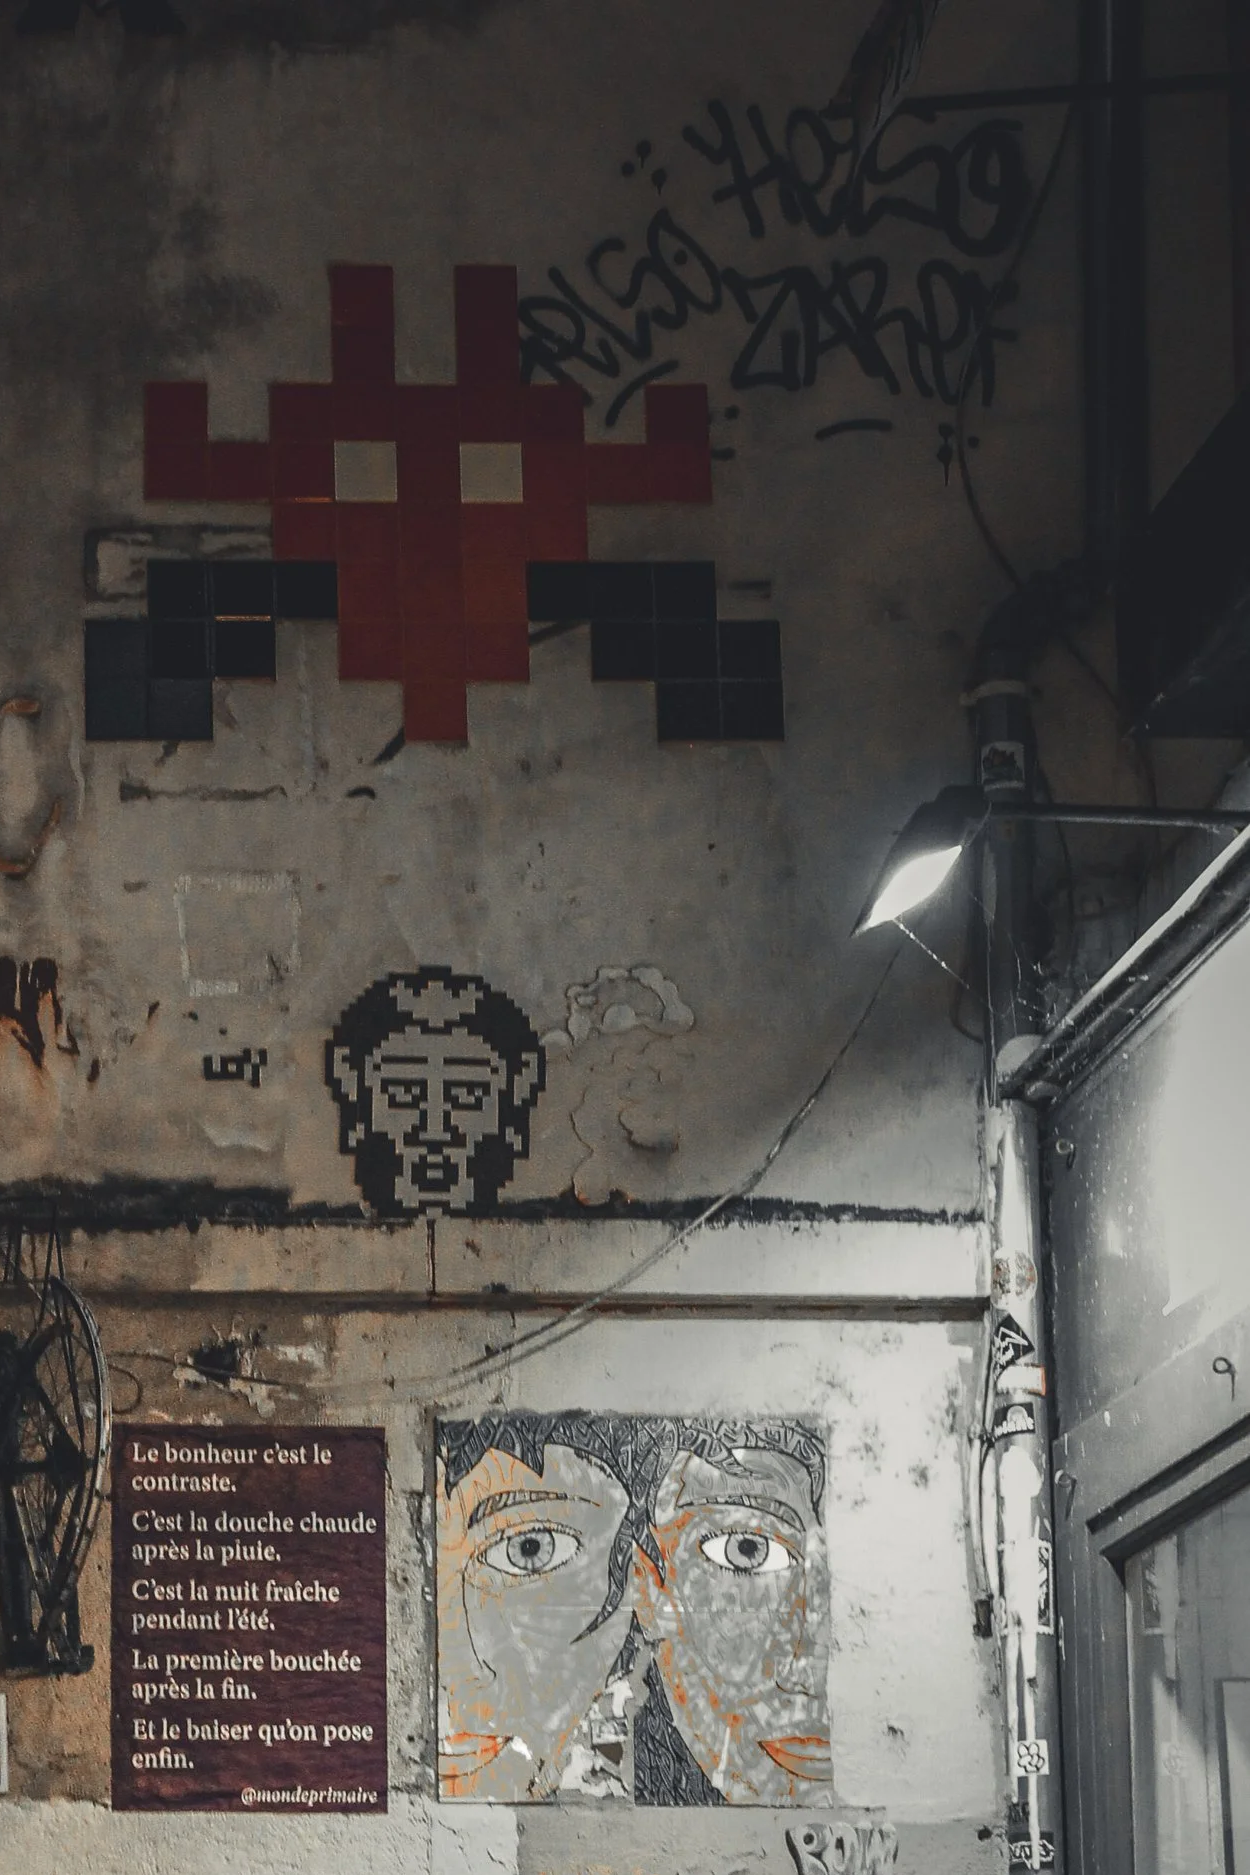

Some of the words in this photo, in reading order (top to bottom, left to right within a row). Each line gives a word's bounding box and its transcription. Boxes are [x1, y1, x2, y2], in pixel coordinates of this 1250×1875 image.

[132, 1442, 159, 1463] Le
[164, 1441, 258, 1464] bonheur
[262, 1442, 307, 1465] c'est
[313, 1442, 332, 1465] le
[131, 1472, 237, 1493] contraste.
[131, 1509, 183, 1532] C'est
[189, 1510, 209, 1532] la
[214, 1510, 294, 1533] douche
[299, 1511, 377, 1534] chaude
[132, 1538, 190, 1566] après
[195, 1538, 215, 1561] la
[220, 1538, 281, 1567] pluie.
[131, 1578, 184, 1601] C'est
[189, 1578, 209, 1602] la
[215, 1580, 260, 1602] nuit
[265, 1578, 340, 1604] fraîche
[131, 1607, 222, 1635] pendant
[227, 1607, 276, 1631] l'été.
[132, 1648, 160, 1671] La
[165, 1648, 265, 1677] première
[269, 1648, 362, 1672] bouchée
[131, 1676, 190, 1705] après
[195, 1677, 216, 1700] la
[221, 1676, 258, 1700] fin.
[133, 1718, 156, 1741] Et
[161, 1717, 181, 1741] le
[186, 1717, 254, 1741] baiser
[257, 1717, 318, 1748] qu'on
[322, 1724, 374, 1747] pose
[131, 1746, 194, 1769] enfin.
[240, 1783, 378, 1808] @mondeprimaire
